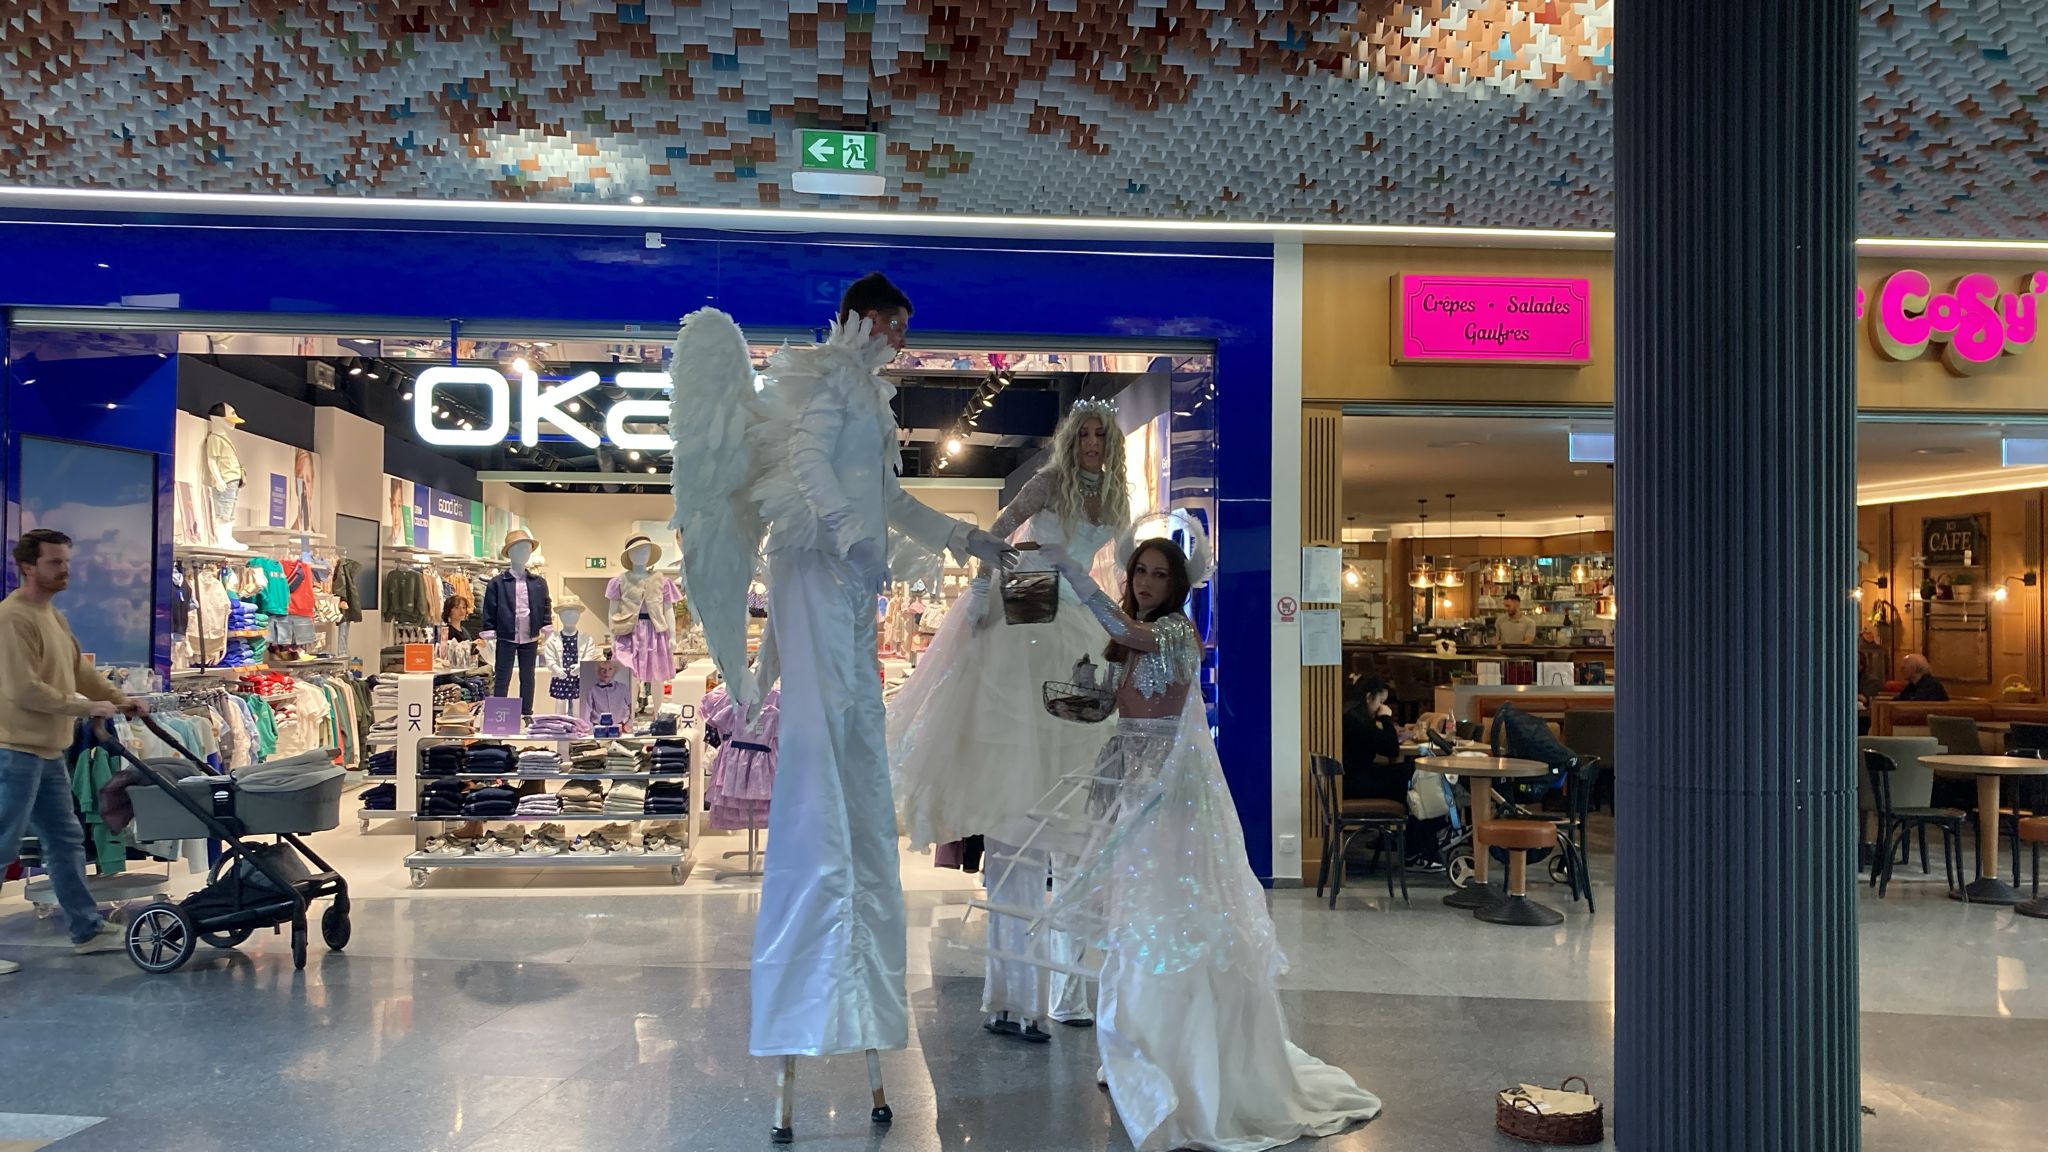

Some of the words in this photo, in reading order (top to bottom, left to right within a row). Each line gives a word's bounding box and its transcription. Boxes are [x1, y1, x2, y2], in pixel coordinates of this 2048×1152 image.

[1423, 293, 1476, 317] Crêpes
[1507, 295, 1571, 314] Salades
[1464, 322, 1530, 346] Gaufres
[408, 703, 421, 731] OK
